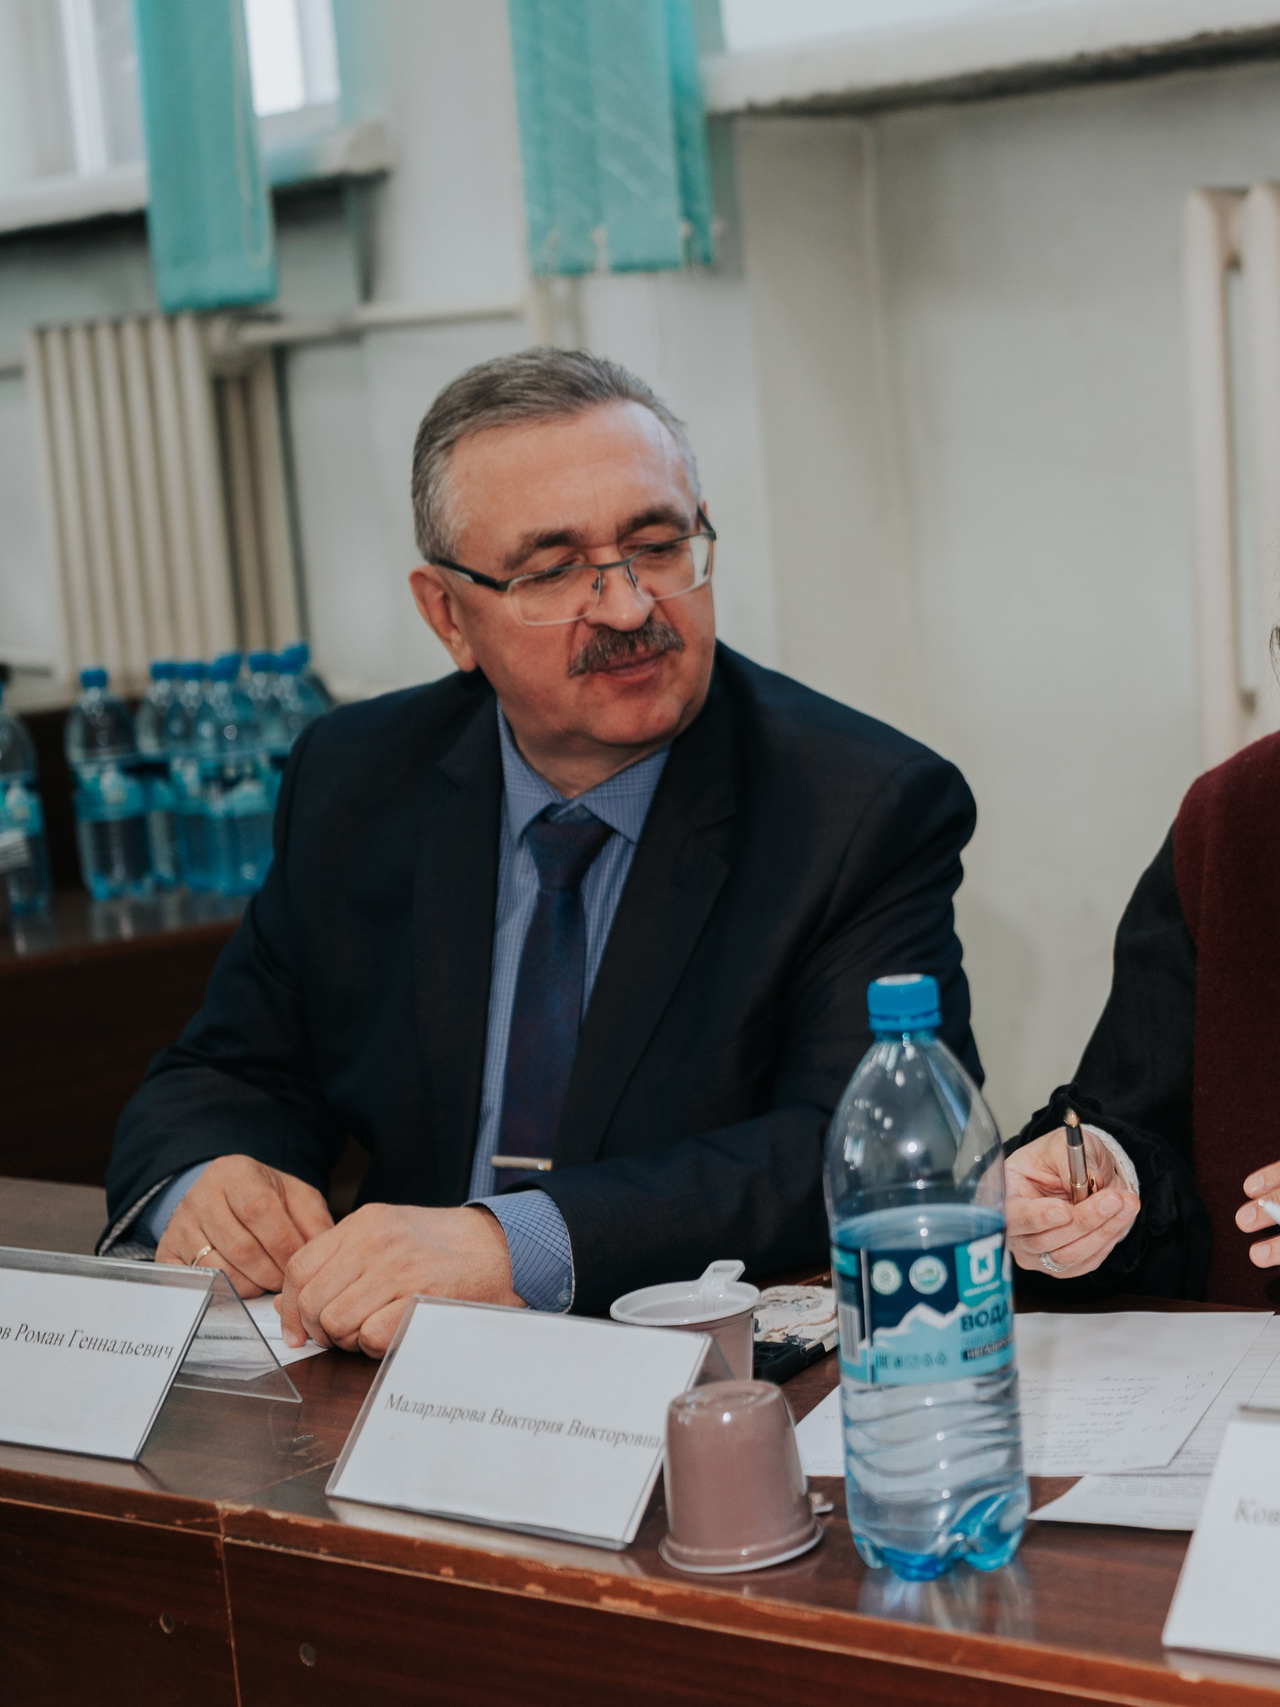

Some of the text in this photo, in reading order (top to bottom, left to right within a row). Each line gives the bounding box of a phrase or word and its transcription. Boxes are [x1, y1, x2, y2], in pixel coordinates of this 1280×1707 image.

[14, 1323, 65, 1347] Роман
[67, 1329, 174, 1360] Геннадьевич
[385, 1393, 661, 1450] Малардырова Виктория Викторовна
